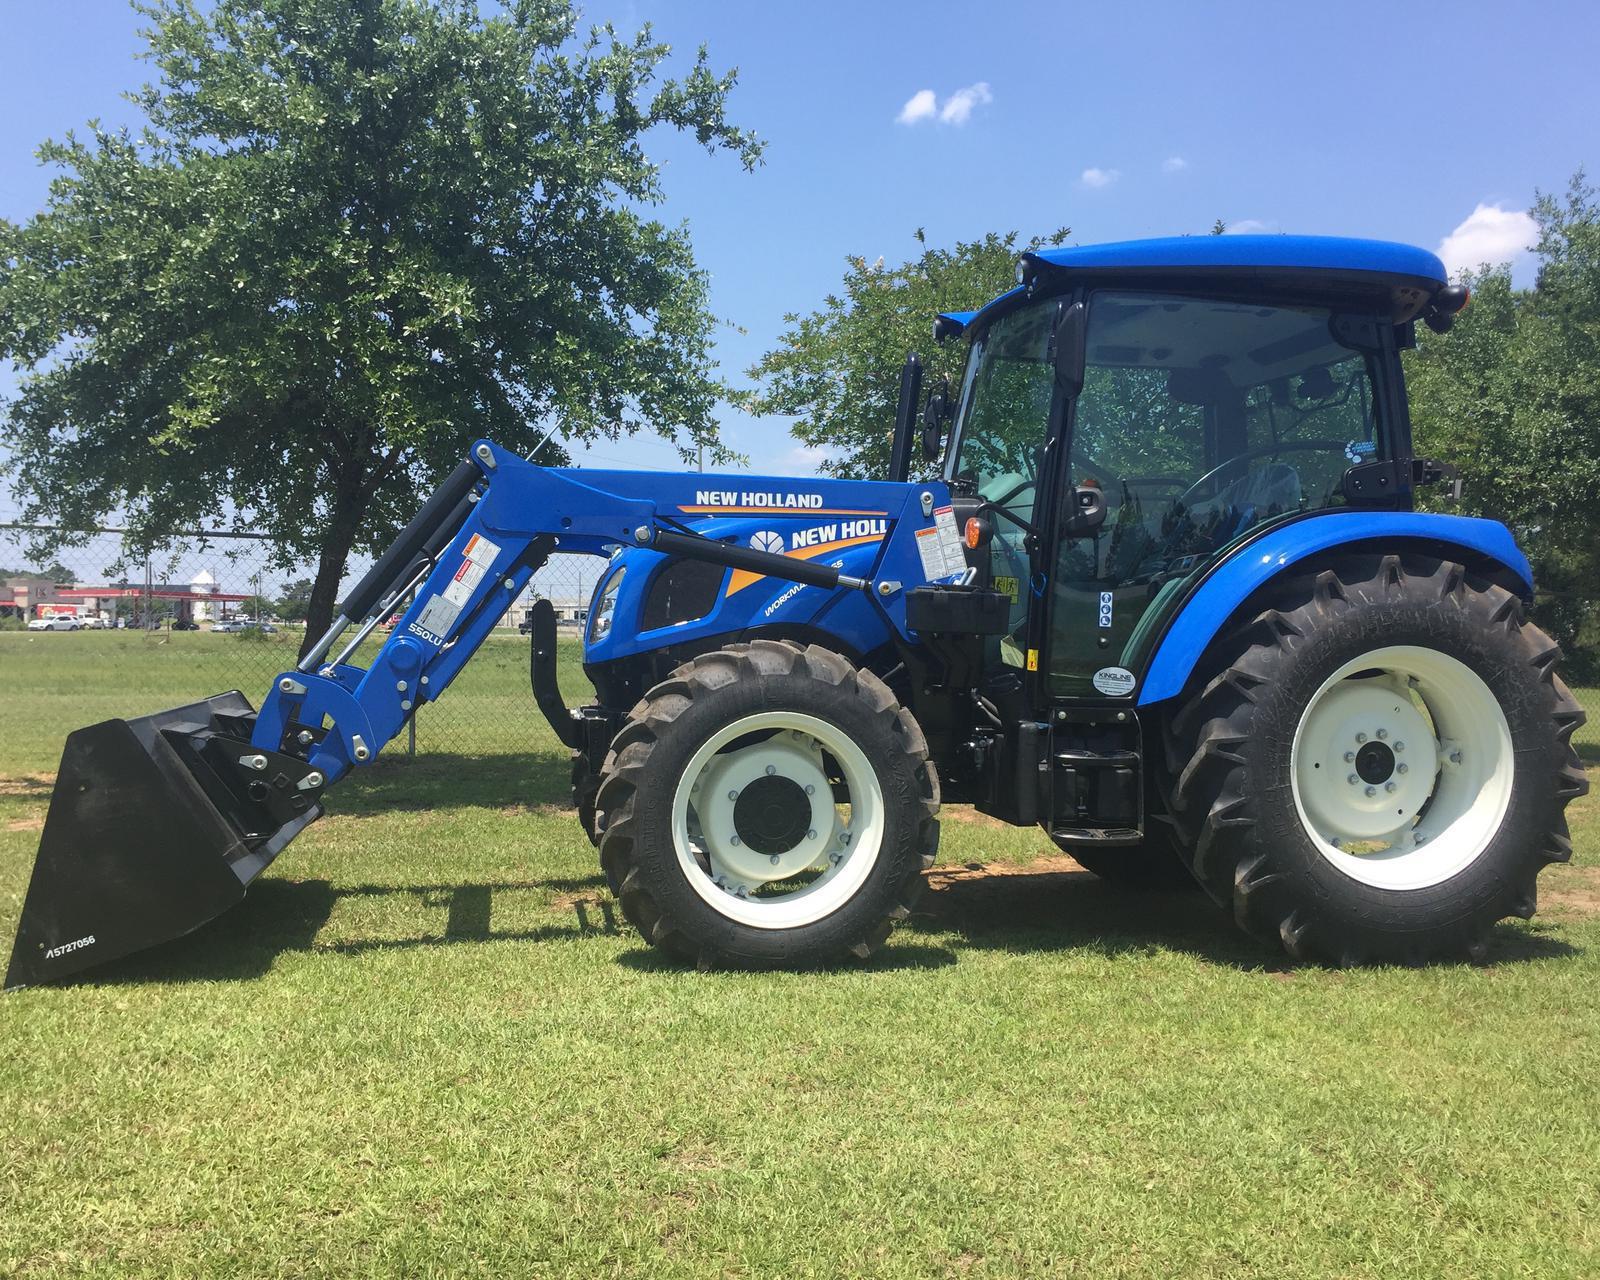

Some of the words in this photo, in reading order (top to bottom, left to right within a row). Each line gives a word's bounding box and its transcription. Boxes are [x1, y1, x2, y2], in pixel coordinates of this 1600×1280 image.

[696, 491, 738, 506] NEW
[741, 492, 823, 508] HOLLAND
[792, 524, 837, 549] NEW
[408, 623, 443, 646] 550LU
